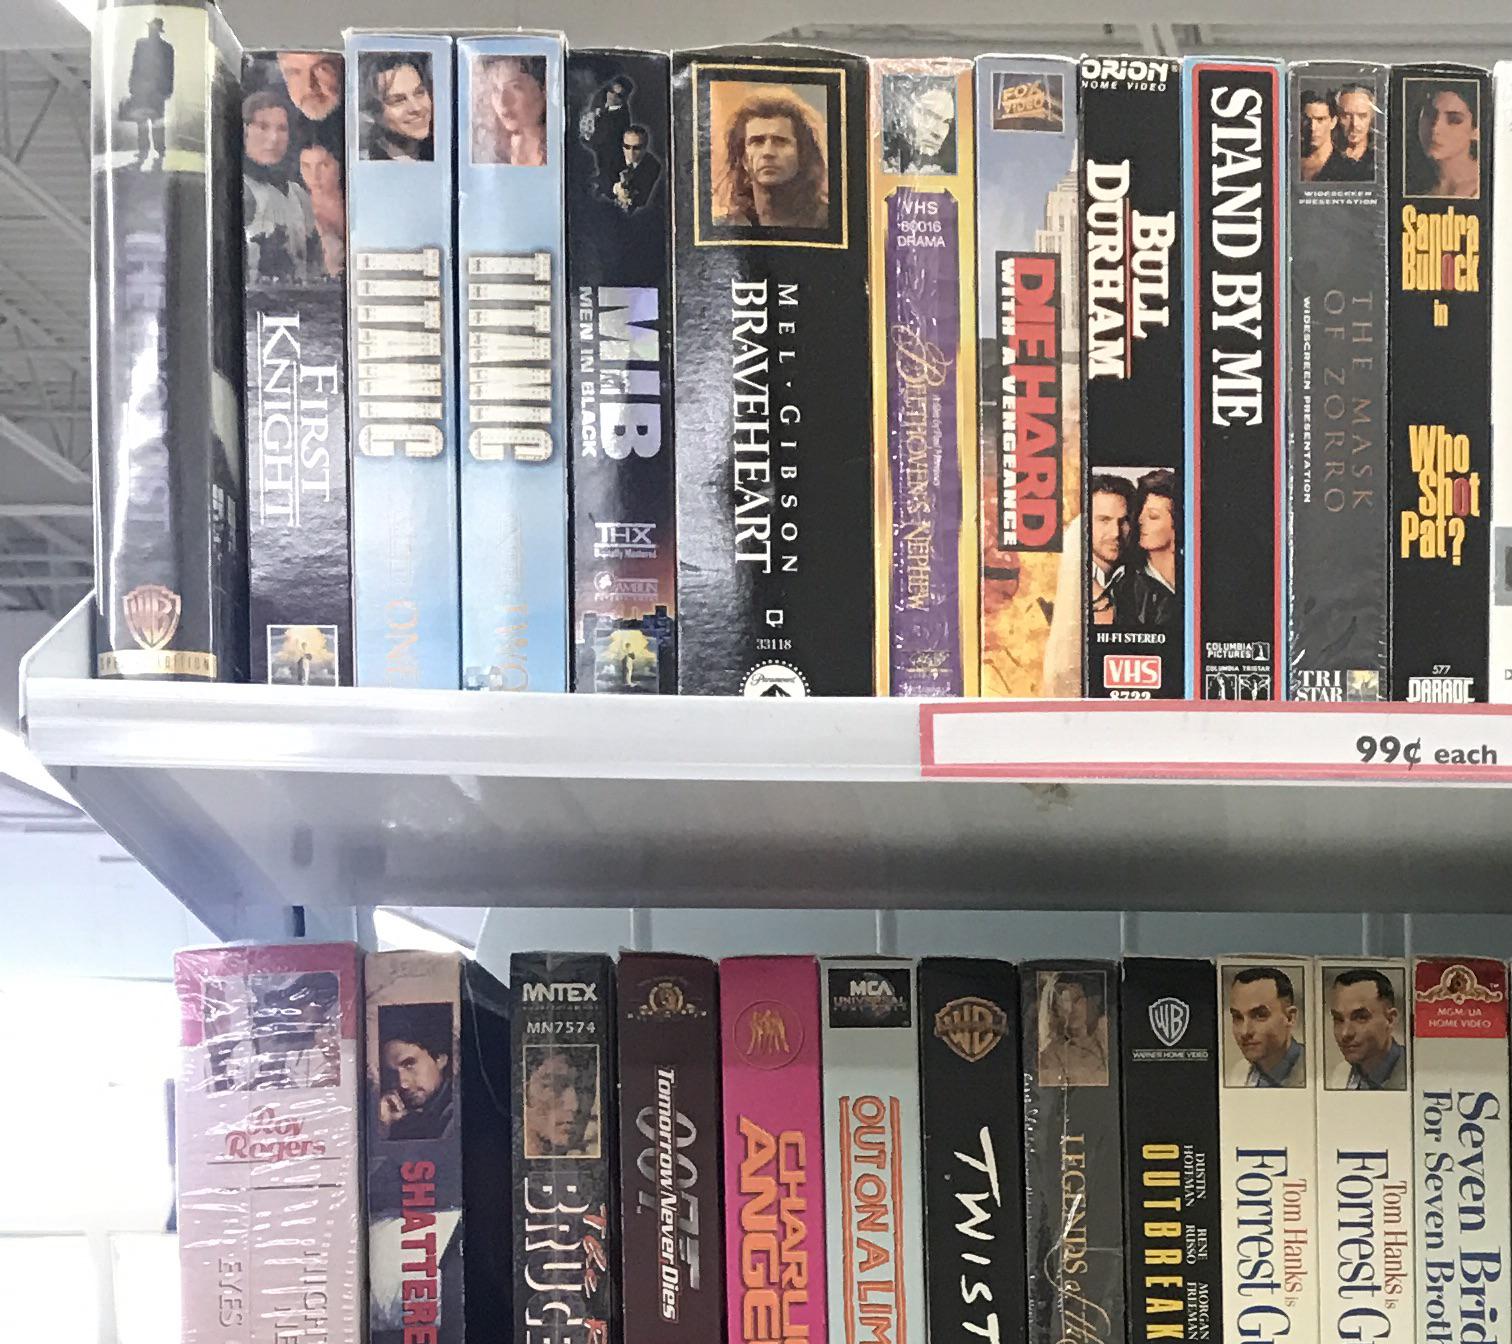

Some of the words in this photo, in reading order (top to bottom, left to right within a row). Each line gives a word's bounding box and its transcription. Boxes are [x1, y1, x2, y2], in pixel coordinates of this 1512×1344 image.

[1081, 59, 1168, 81] ORION
[1211, 85, 1263, 259] STAND
[579, 286, 593, 344] MEN
[1015, 258, 1056, 358] DIE
[1087, 160, 1130, 380] DURHAM
[1131, 211, 1175, 339] BULL
[1211, 272, 1263, 341] BY
[259, 314, 301, 525] KNIGHT
[357, 248, 443, 462] TITANIC
[580, 353, 594, 374] IN
[580, 382, 596, 456] BLACK
[598, 286, 661, 462] MIB
[1211, 347, 1263, 427] ME
[299, 361, 338, 501] FIRST
[732, 279, 772, 573] BRAVEHEART
[1015, 365, 1057, 547] HARD
[756, 638, 792, 650] 33118
[1107, 661, 1157, 682] VHS
[1356, 735, 1421, 771] 99¢
[1434, 745, 1497, 764] each
[1236, 1147, 1287, 1297] Forrest
[1457, 1090, 1501, 1232] Seven
[1142, 1145, 1185, 1340] OUTBREAK
